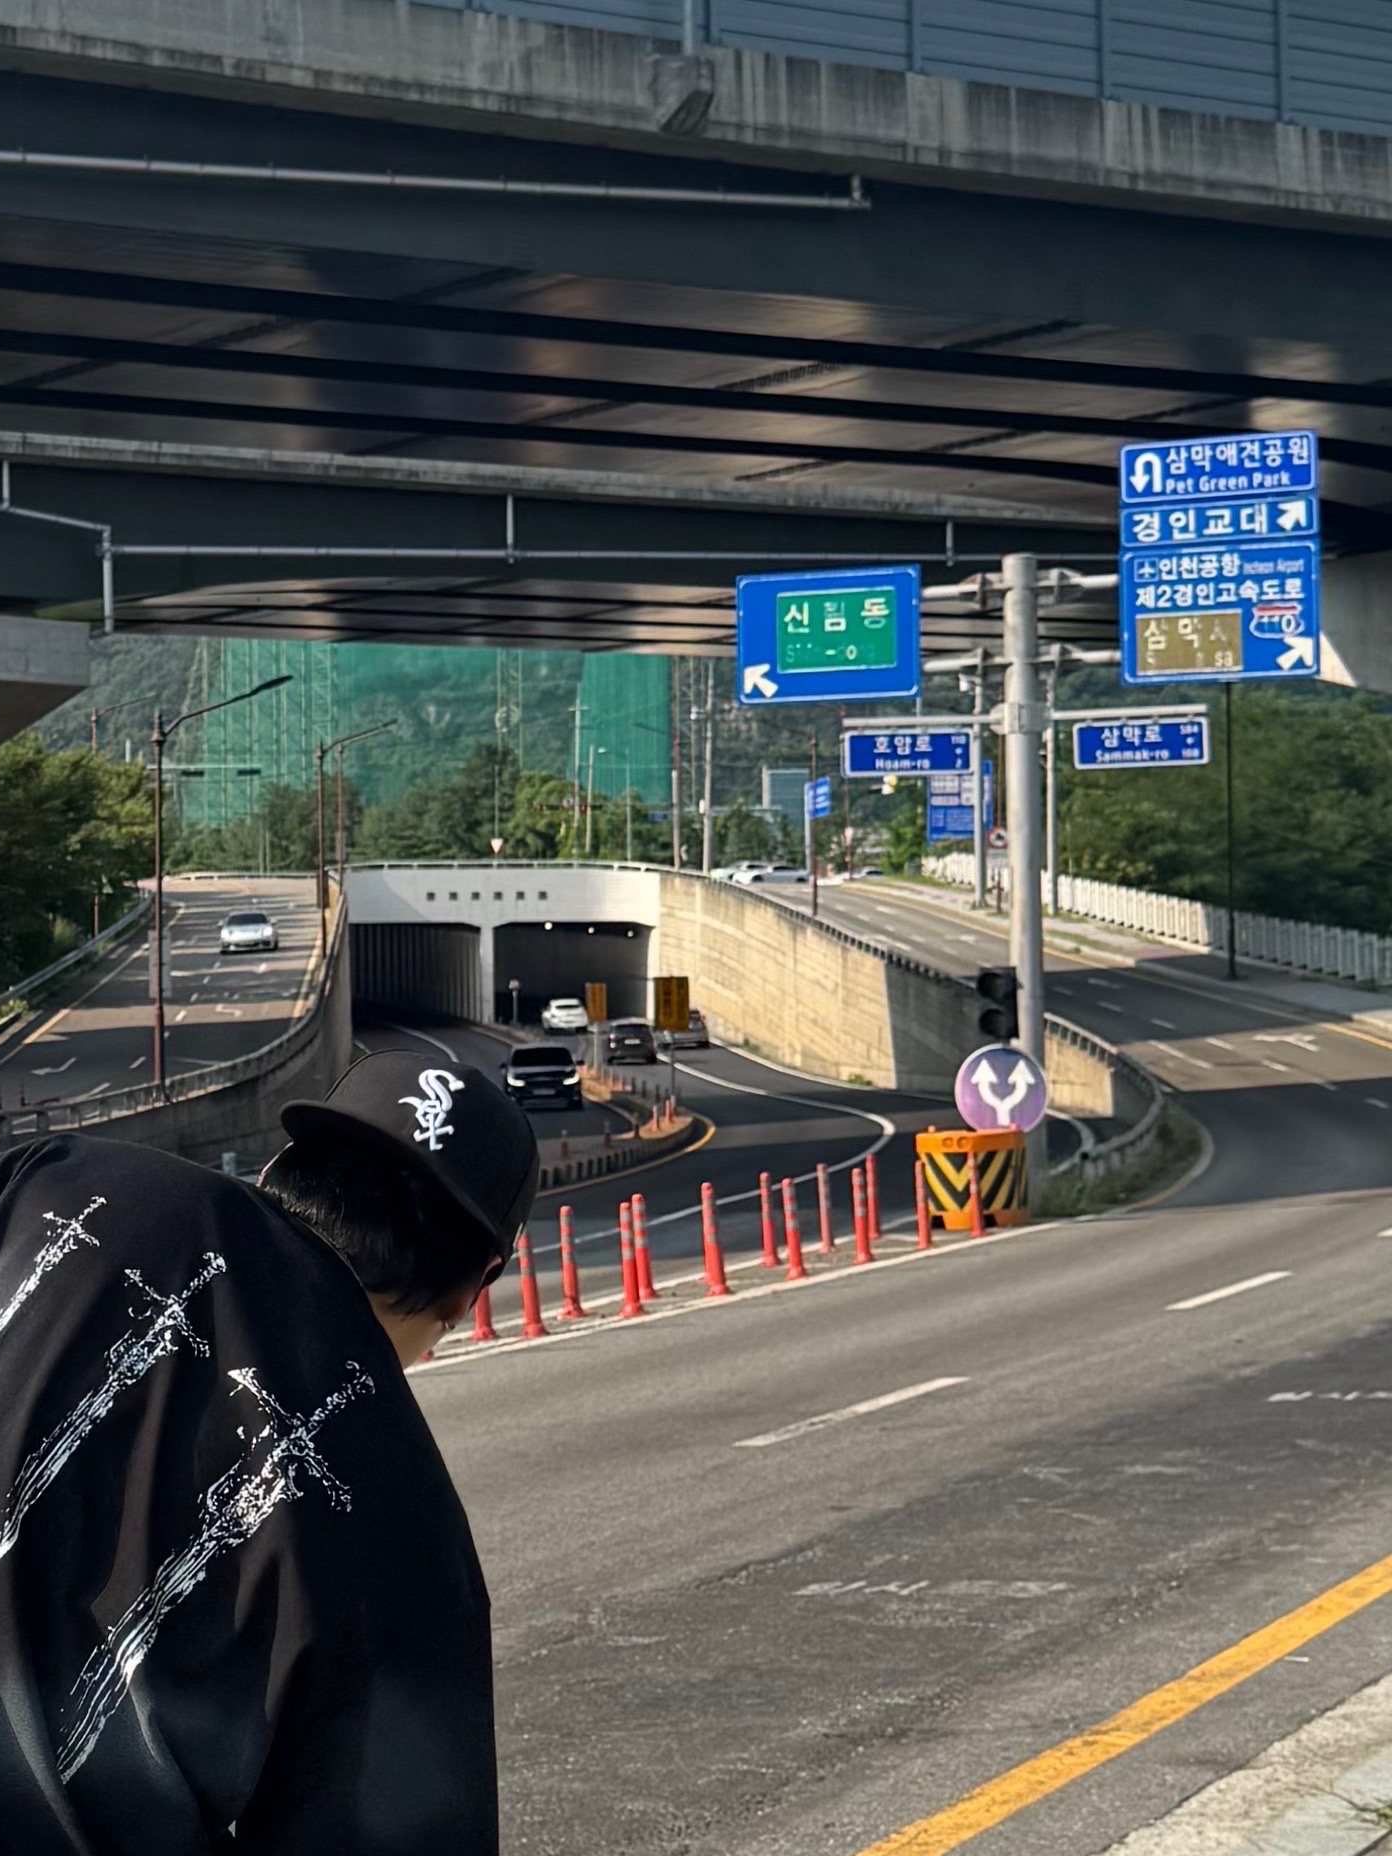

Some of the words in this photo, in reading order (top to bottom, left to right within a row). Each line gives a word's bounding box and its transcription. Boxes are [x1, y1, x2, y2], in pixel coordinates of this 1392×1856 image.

[1165, 437, 1309, 475] 삼막애견공원
[1166, 478, 1194, 494] Pet
[1199, 475, 1248, 492] Green
[1252, 470, 1291, 487] Park
[1132, 503, 1268, 544] 경인교대
[1159, 553, 1241, 580] 인천공항
[1135, 578, 1305, 608] 제2경인고속도로
[873, 736, 933, 755] 호암로
[1101, 725, 1162, 748] 삼막로
[875, 758, 931, 770] Hoam-ro
[1095, 749, 1169, 763] Sammak-ro
